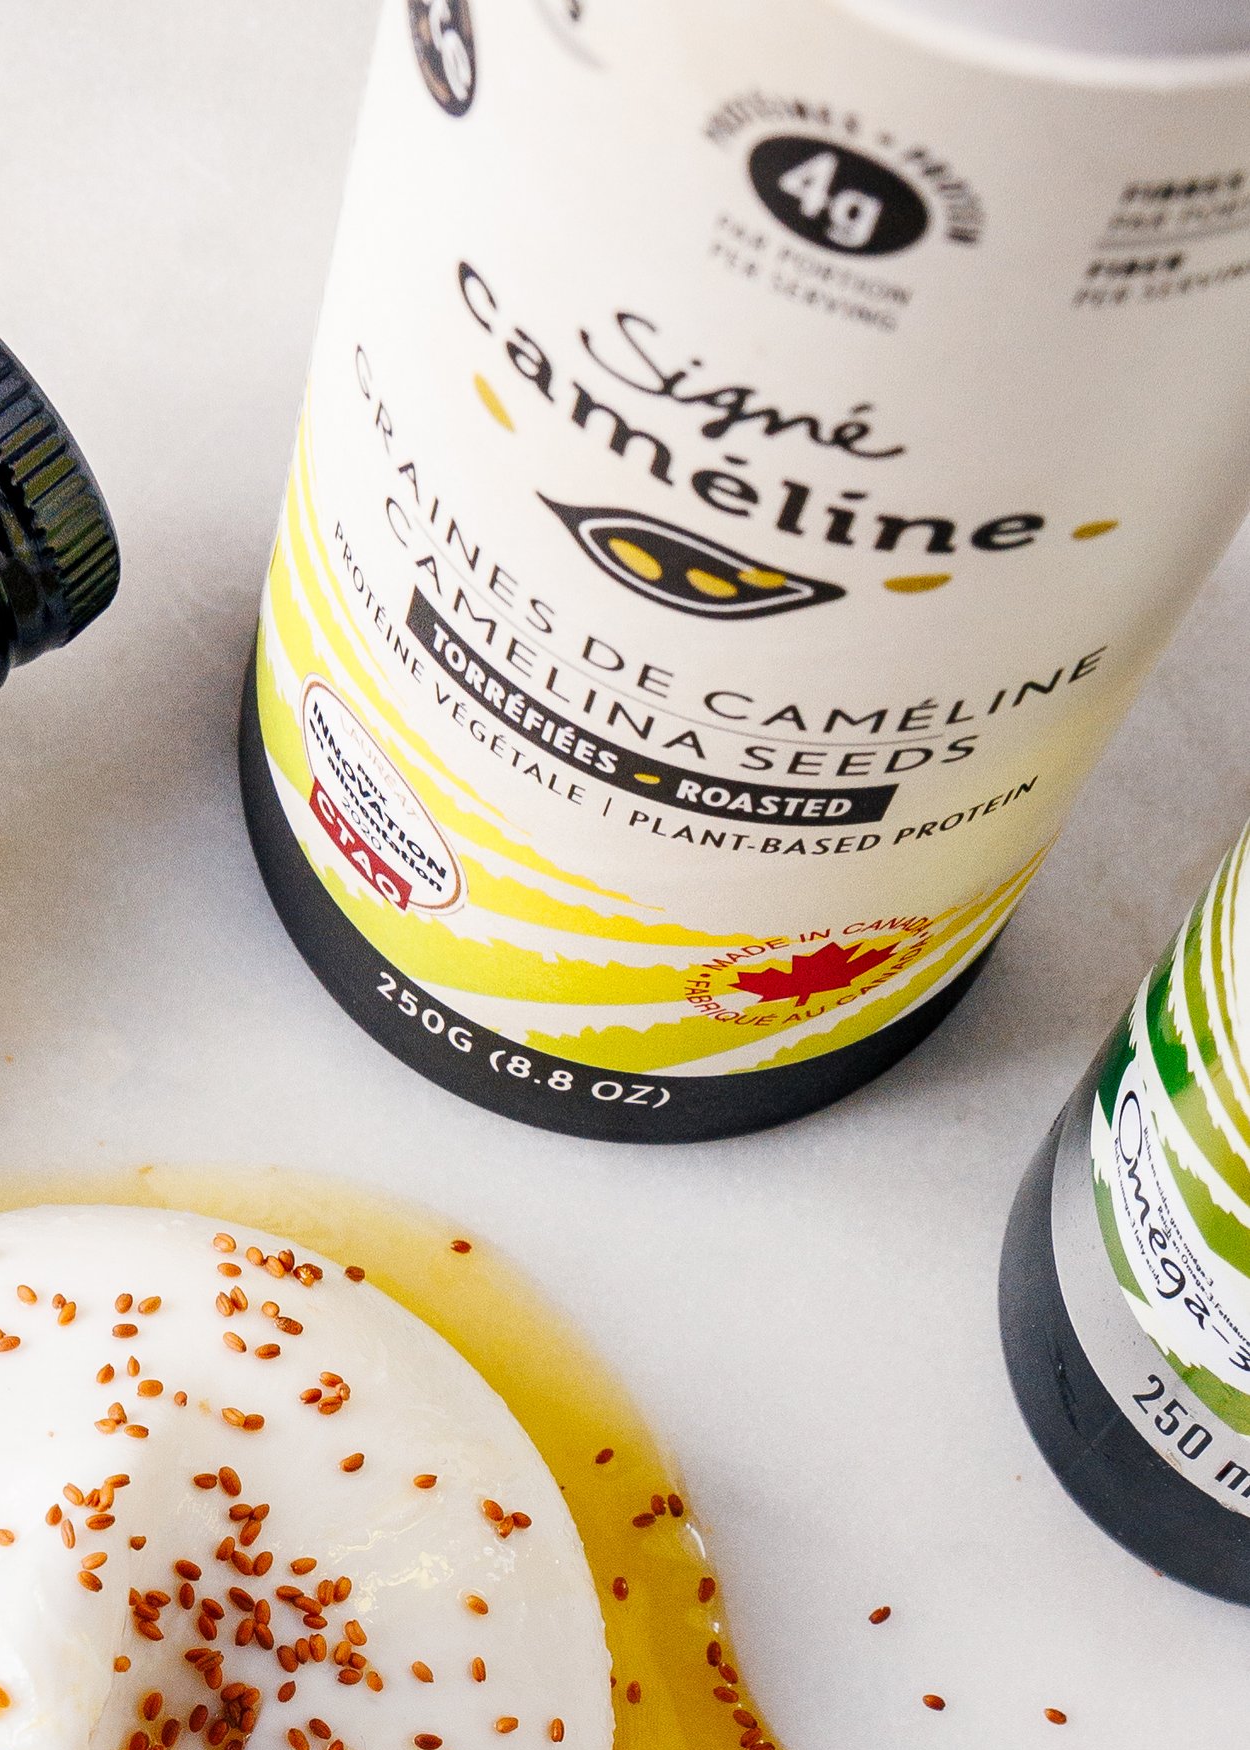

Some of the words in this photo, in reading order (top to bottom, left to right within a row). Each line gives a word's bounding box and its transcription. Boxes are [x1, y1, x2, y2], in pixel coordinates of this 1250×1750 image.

[778, 151, 884, 249] 4g
[457, 260, 1045, 556] caméline
[578, 311, 906, 460] Signé
[355, 344, 556, 634] GRAINES
[582, 636, 674, 698] DE
[703, 644, 1109, 734] CAMÉLINE
[334, 521, 425, 685] PROTÉINE
[435, 681, 588, 806] VÉGÉTALE
[628, 809, 882, 856] PLANT-BASED
[892, 775, 1039, 846] PROTEIN
[385, 496, 707, 761] CAMELINA
[739, 734, 980, 777] SEEDS
[312, 701, 448, 880] INNOVATION
[429, 622, 619, 775] TORRÉFIÉES
[674, 777, 854, 818] ROASTED
[316, 790, 403, 904] CTAQ
[683, 979, 778, 1027] FABRIQUÉ
[784, 1006, 826, 1024] AU
[705, 937, 790, 972] MADE
[799, 928, 832, 944] IN
[376, 971, 474, 1053] 250G
[488, 1050, 575, 1092] (8.8
[591, 1080, 672, 1109] OZ)
[1132, 1374, 1214, 1461] 250
